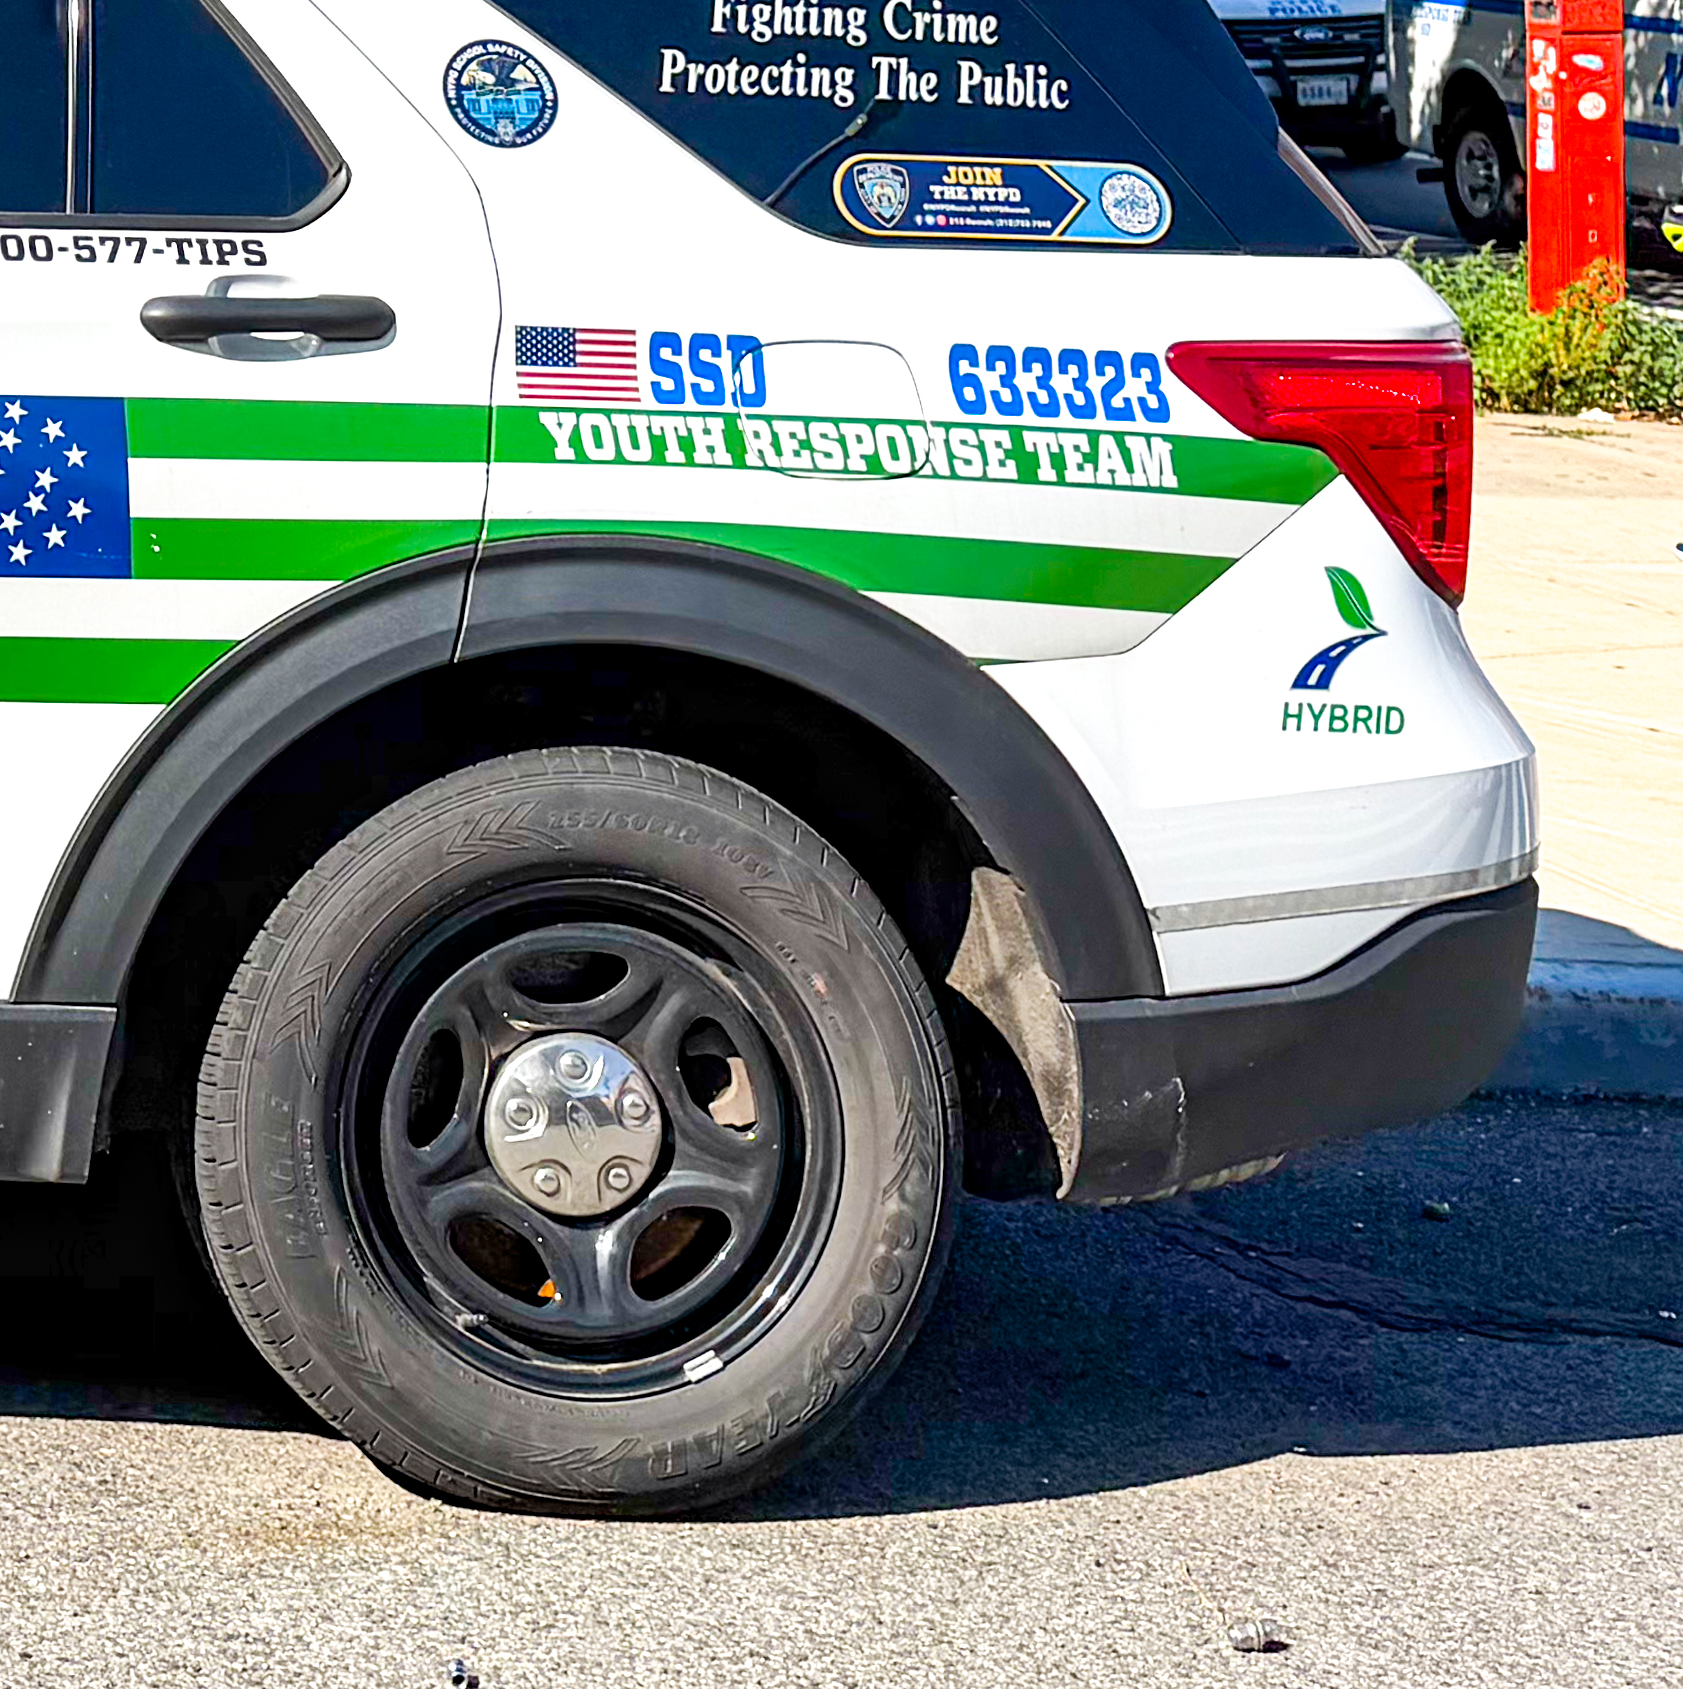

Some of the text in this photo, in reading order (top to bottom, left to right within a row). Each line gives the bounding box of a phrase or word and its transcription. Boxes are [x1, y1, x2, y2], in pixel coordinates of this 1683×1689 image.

[658, 48, 1070, 109] Protecting The Public
[929, 185, 1022, 203] THE NYPD
[942, 165, 1003, 186] JOIN
[649, 331, 766, 408] SSD
[948, 343, 1170, 423] 633323
[539, 411, 1179, 488] YOUTH RESPONSE TEAM
[1282, 702, 1405, 735] HYBRID
